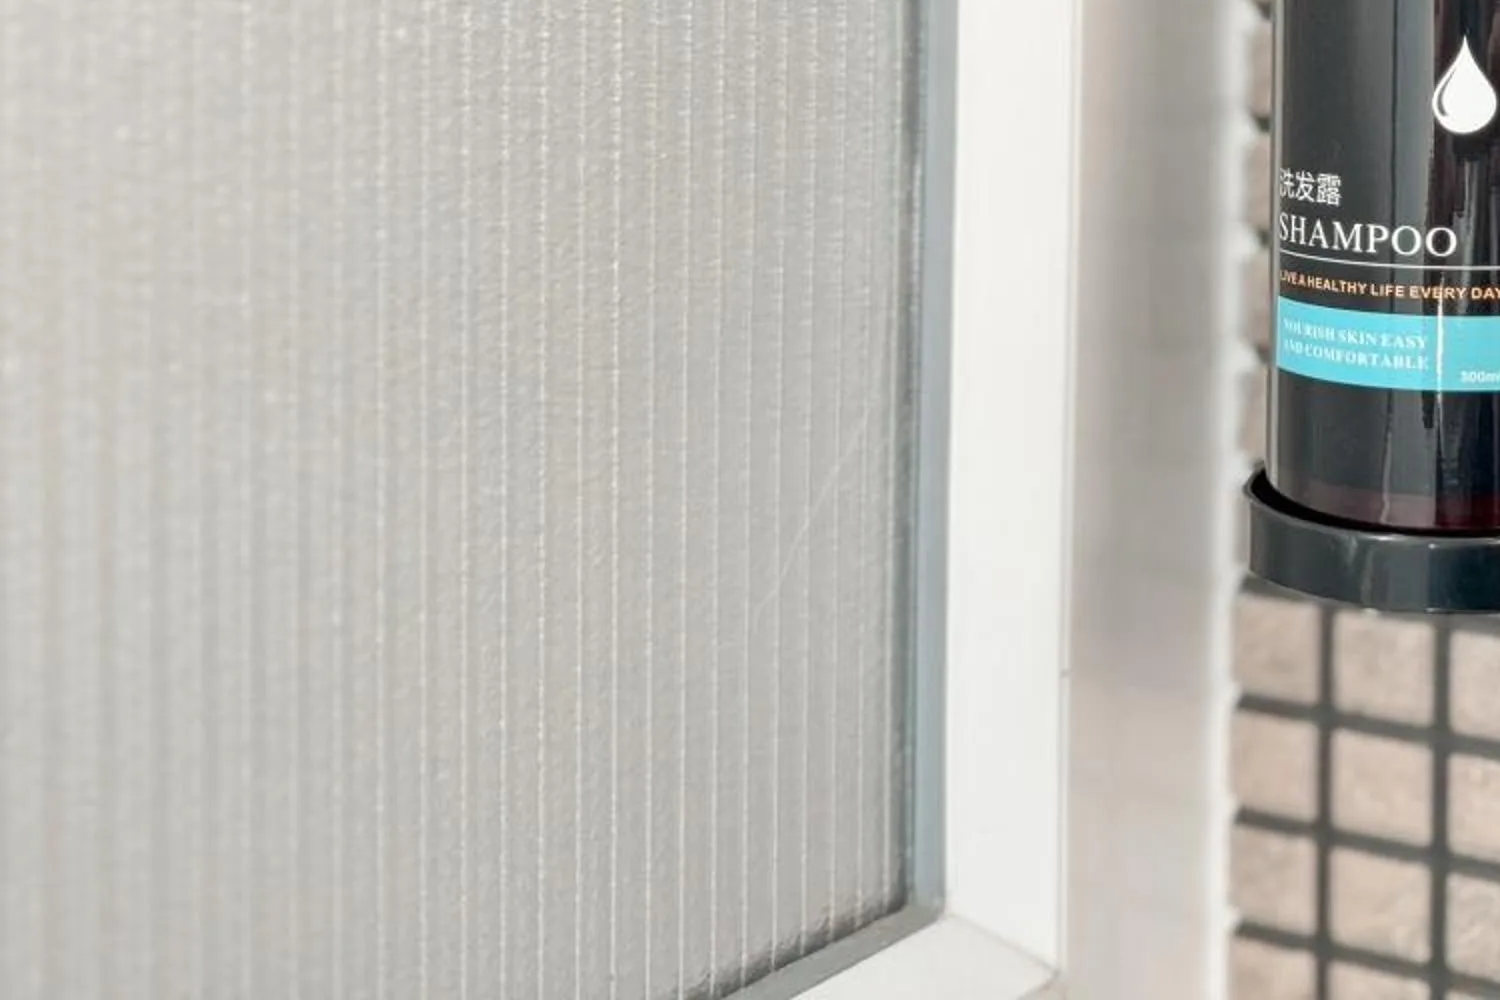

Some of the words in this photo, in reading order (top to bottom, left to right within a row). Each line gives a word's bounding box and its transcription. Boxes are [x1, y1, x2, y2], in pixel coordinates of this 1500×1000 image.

[1279, 212, 1457, 257] SHAMPOO
[1307, 275, 1367, 295] HEALTHY
[1370, 283, 1404, 298] LIFE
[1409, 285, 1467, 299] EVERY
[1338, 328, 1378, 346] SKIN
[1380, 332, 1428, 350] EASY
[1305, 343, 1429, 371] COMFORTABLE
